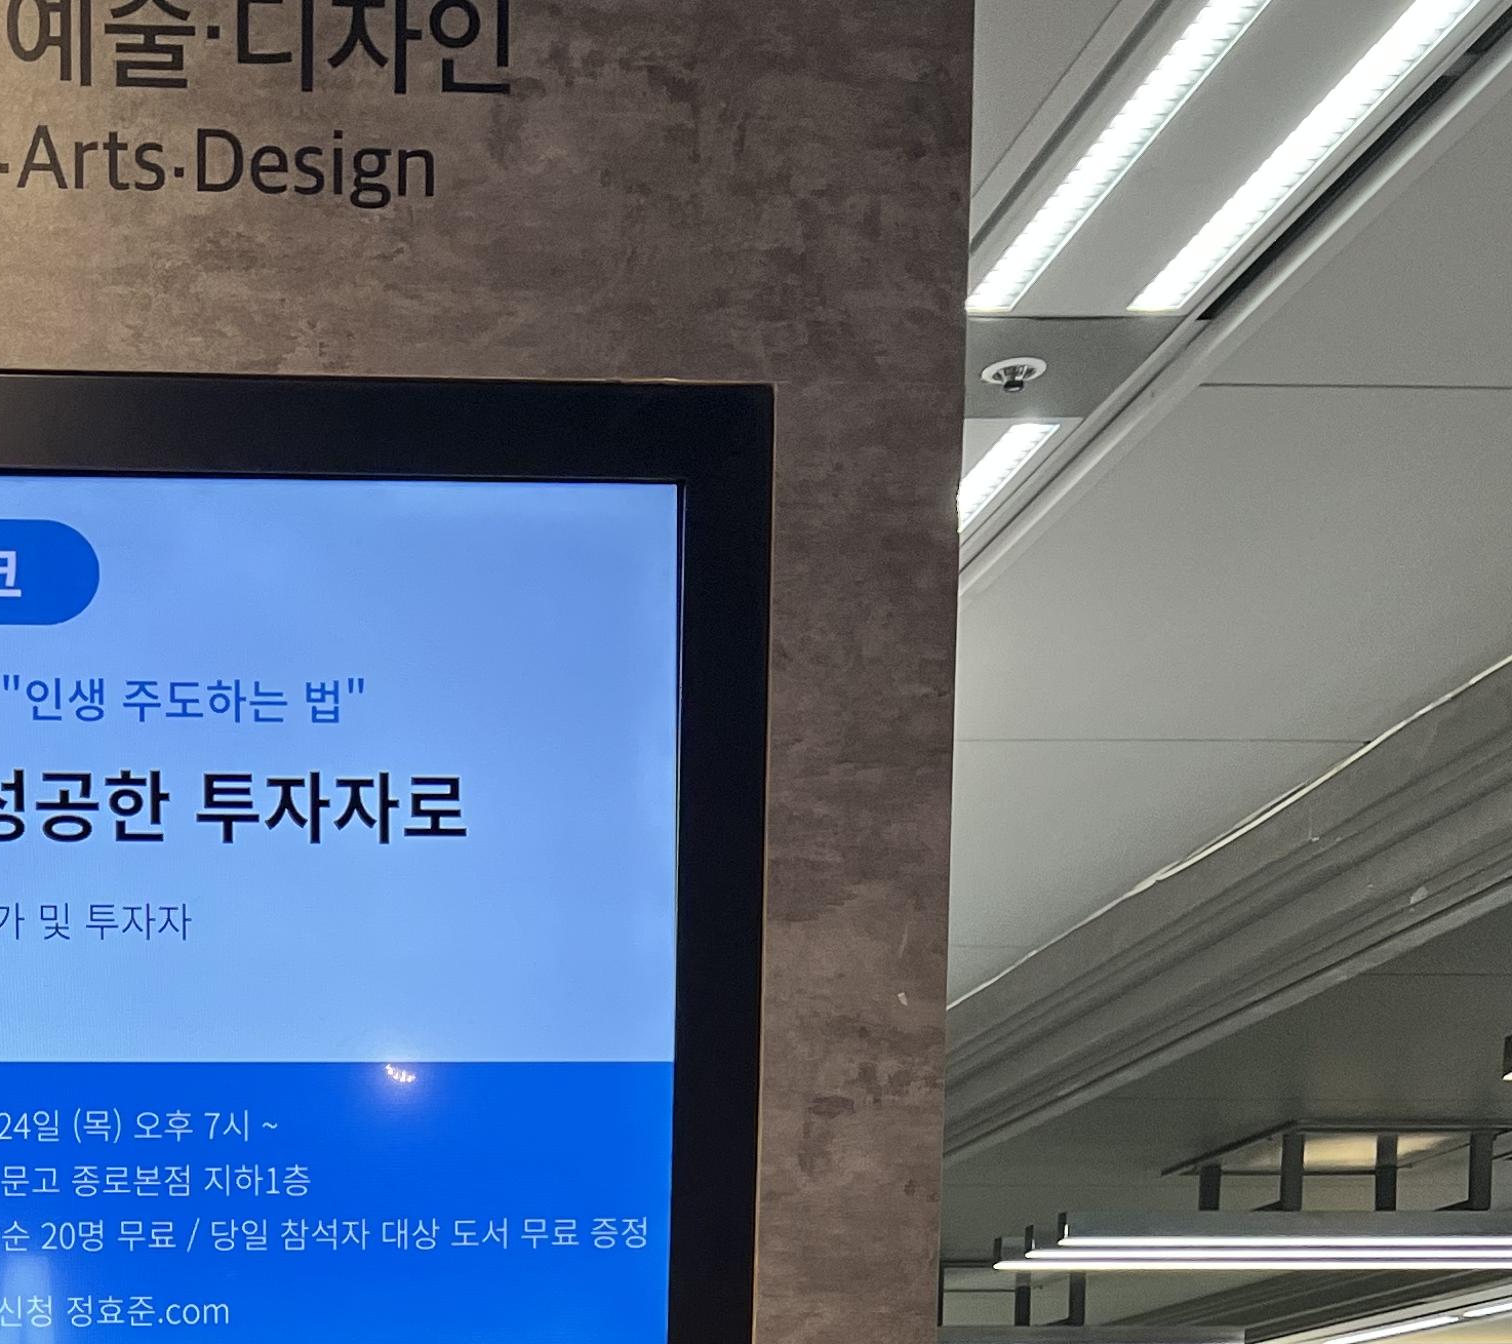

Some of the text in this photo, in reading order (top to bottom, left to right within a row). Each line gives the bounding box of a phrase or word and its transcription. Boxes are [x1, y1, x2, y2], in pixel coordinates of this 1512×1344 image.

[4, 675, 104, 721] "인생
[123, 680, 287, 723] 주도하는
[306, 678, 364, 723] 법"
[197, 772, 466, 844] 투자자로
[41, 903, 70, 940] 및
[86, 903, 192, 940] 투자자
[74, 1108, 121, 1143] (목)
[134, 1110, 193, 1141] 오후
[205, 1110, 248, 1141] 7시
[72, 1165, 189, 1196] 종로본점
[205, 1164, 310, 1196] 지하1층
[41, 1220, 103, 1251] 20명
[118, 1221, 176, 1251] 무료
[212, 1219, 267, 1251] 당일
[281, 1219, 369, 1250] 참석자
[383, 1218, 440, 1249] 대상
[452, 1218, 507, 1249] 도서
[521, 1219, 579, 1249] 무료
[591, 1217, 646, 1248] 증정
[67, 1296, 228, 1327] 정효준.com
